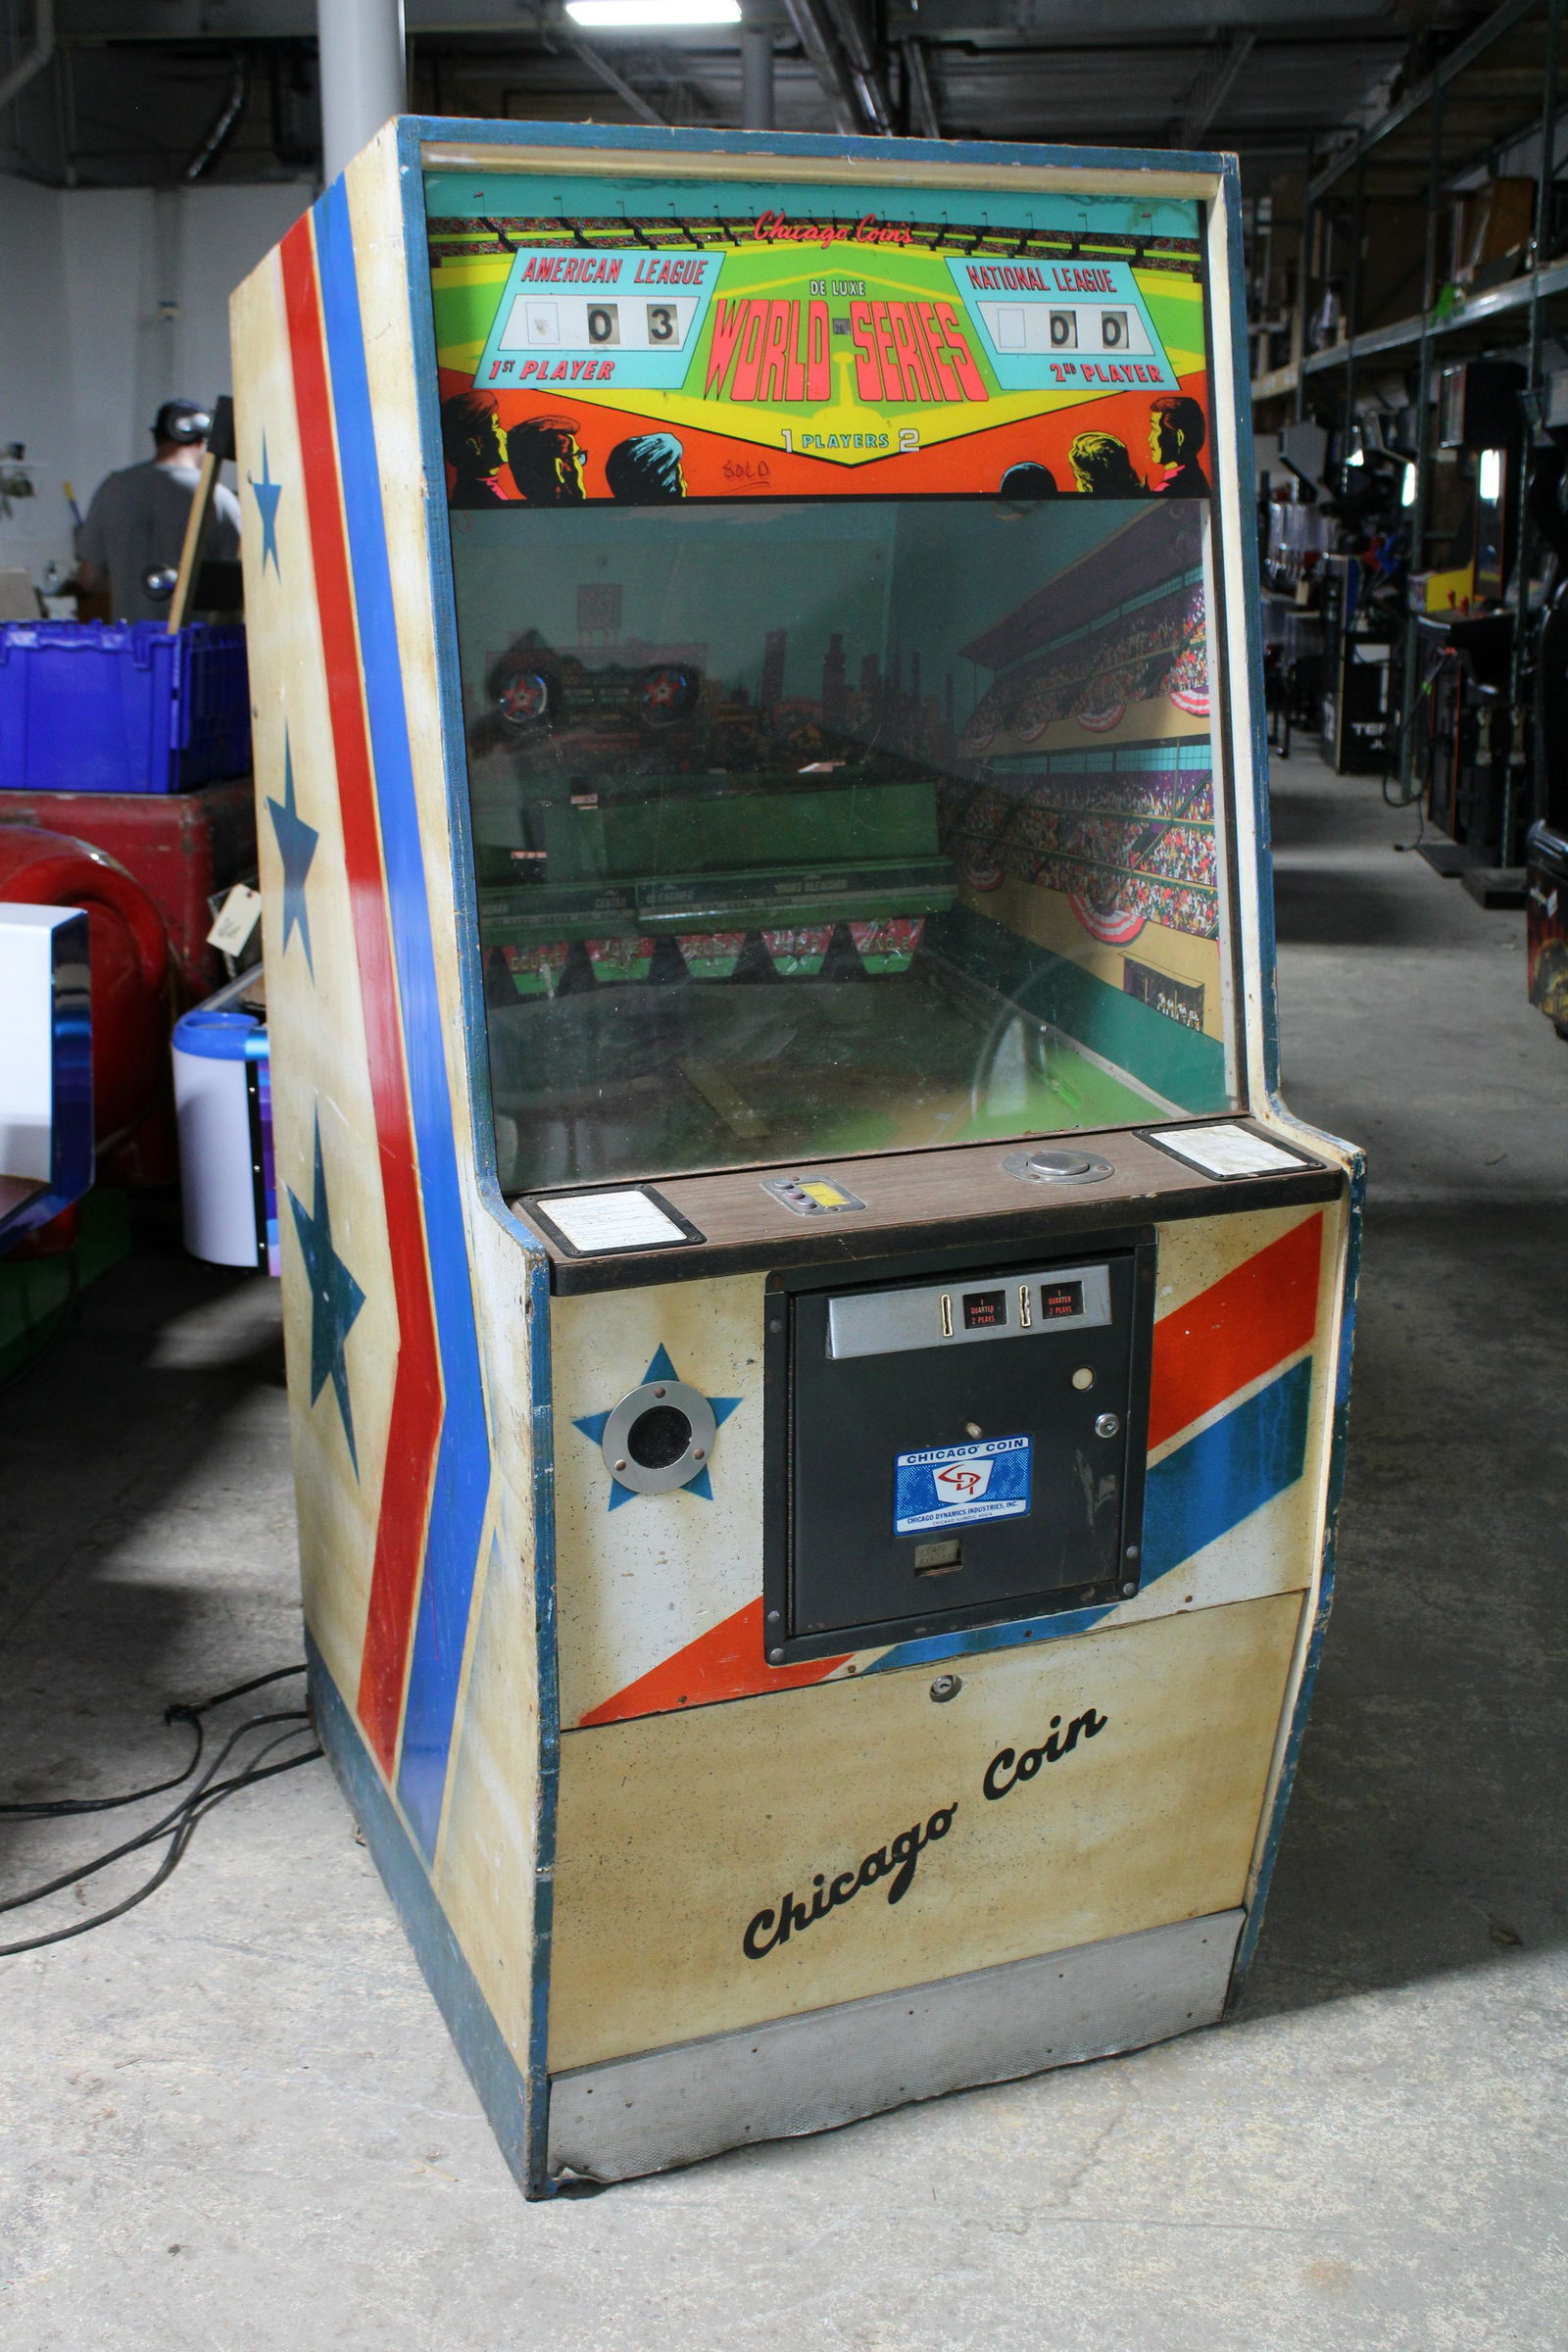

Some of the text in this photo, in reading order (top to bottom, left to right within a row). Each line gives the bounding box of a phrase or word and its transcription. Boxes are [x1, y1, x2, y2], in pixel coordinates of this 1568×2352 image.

[754, 210, 849, 249] Chicago
[521, 257, 709, 285] AMERICAN LEAGUE
[965, 266, 1117, 293] NATIONAL LEAGUE
[809, 279, 866, 296] DE LUXE
[651, 309, 673, 340] 3
[704, 299, 990, 402] WORLD SERIES
[489, 361, 615, 380] 1ST PLAYER
[1050, 363, 1164, 382] 2ND PLAYER
[781, 428, 919, 453] 1 PLAYERS 2
[722, 460, 770, 478] SOLD
[970, 1304, 995, 1315] QUARTER
[1048, 1296, 1072, 1305] QUARTER
[1054, 1305, 1073, 1314] PLAYS
[977, 1315, 996, 1324] PLAYS
[906, 1439, 1024, 1464] CHICAGO COIN
[906, 1514, 935, 1525] CHICAGO
[935, 1508, 967, 1520] DYNAMICS
[967, 1503, 1005, 1515] INDUSTRIES,
[743, 1707, 1108, 1960] Chicago Coin
